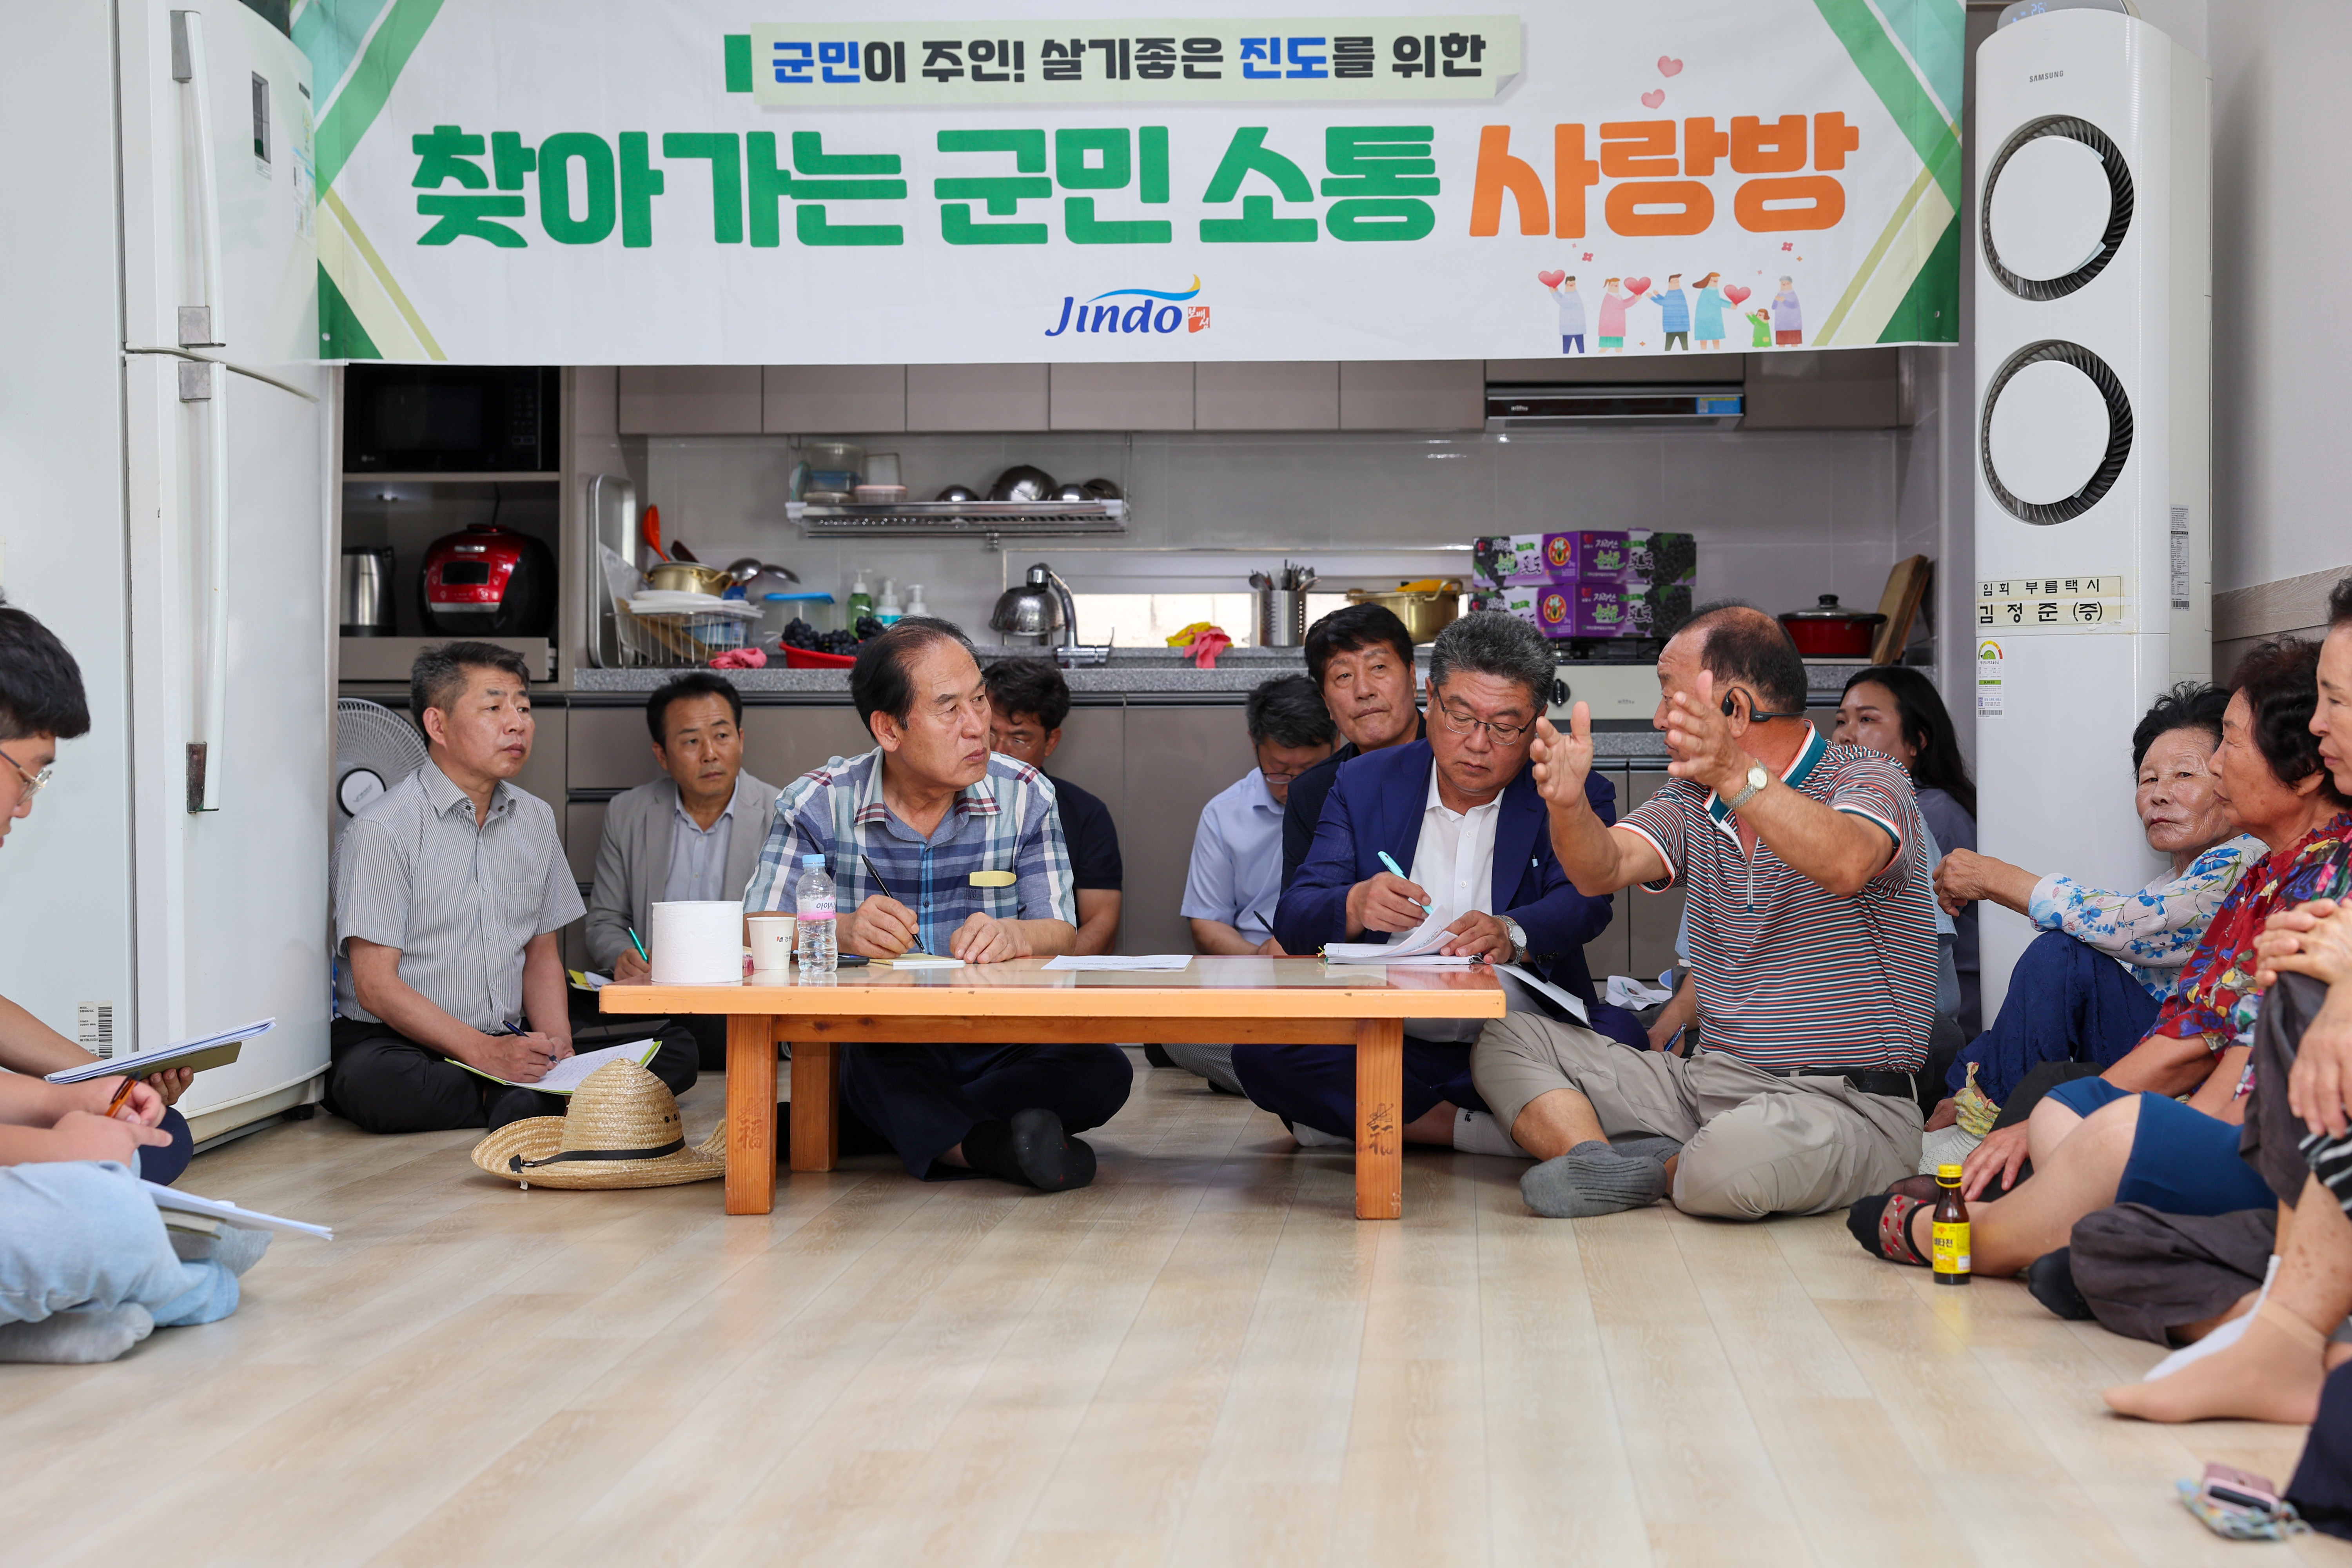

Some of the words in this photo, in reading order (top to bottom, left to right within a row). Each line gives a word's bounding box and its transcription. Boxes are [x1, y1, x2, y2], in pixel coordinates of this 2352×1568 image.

[773, 42, 906, 83] 군민이
[922, 40, 1024, 82] 주인!
[1041, 38, 1223, 80] 살기좋은
[1240, 36, 1375, 79] 진도를
[1392, 33, 1486, 78] 위한
[2029, 70, 2063, 82] SAMSUNG
[412, 125, 907, 248] 찾아가는
[934, 126, 1172, 245] 군민
[1200, 126, 1440, 243] 소통
[1469, 111, 1859, 239] 사랑방
[1045, 296, 1182, 336] Jindo
[1984, 582, 2009, 596] 임회
[2025, 578, 2100, 595] 부름택시
